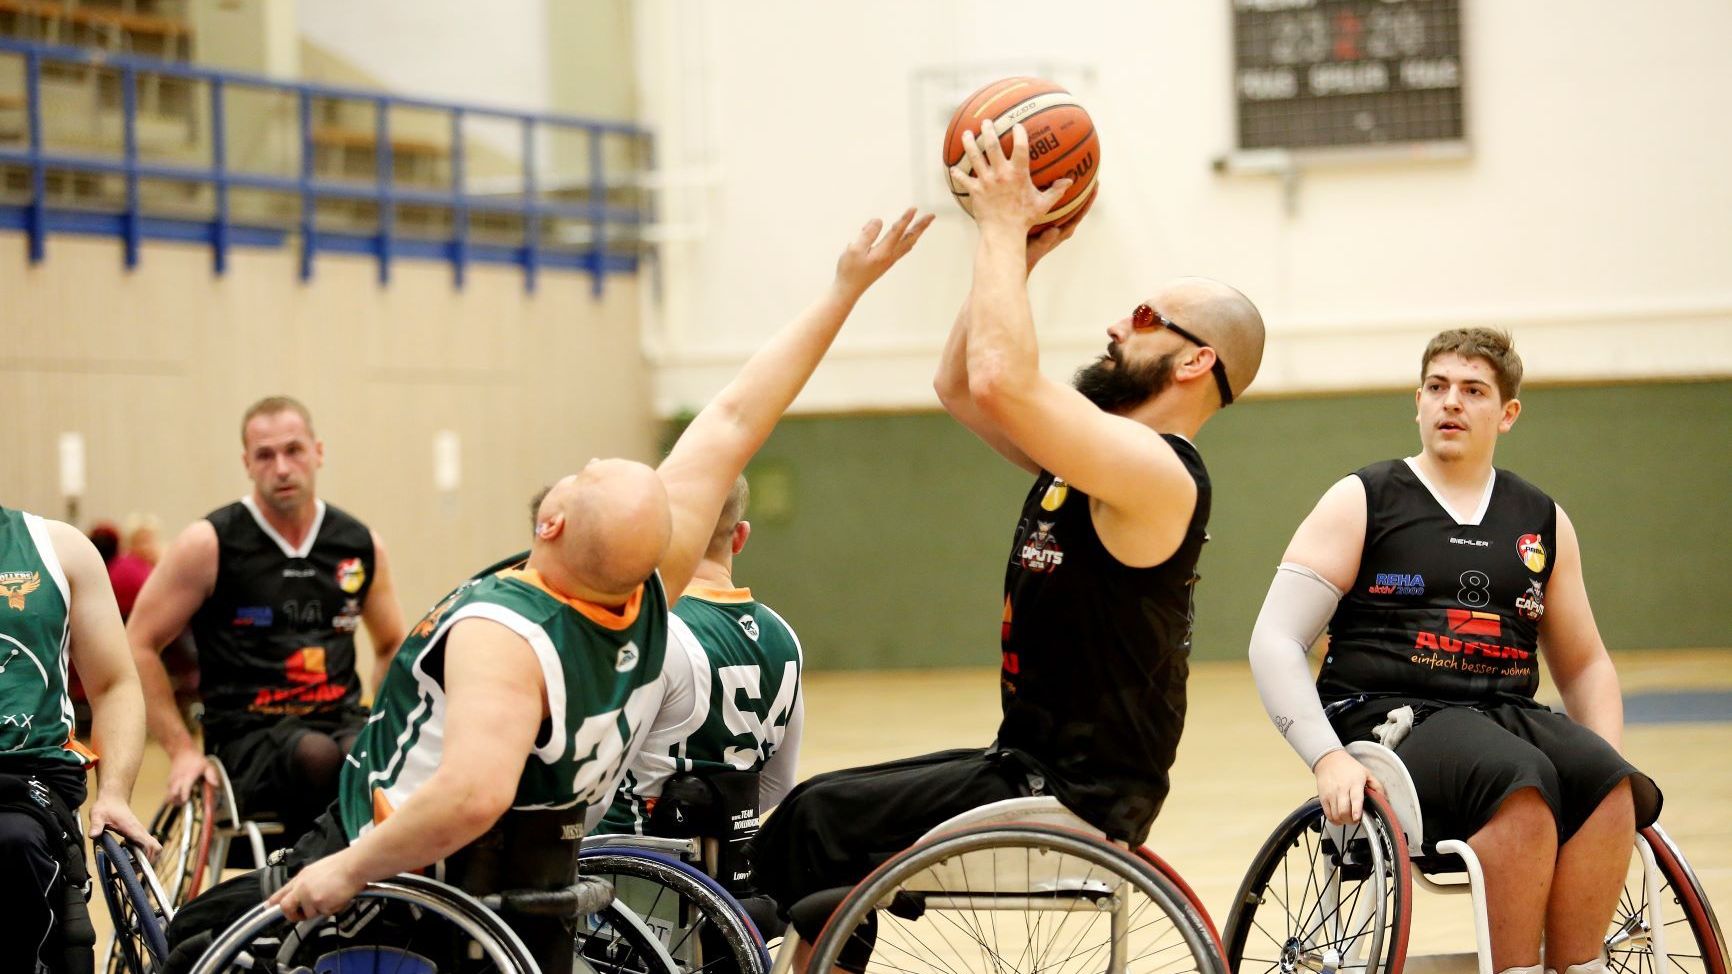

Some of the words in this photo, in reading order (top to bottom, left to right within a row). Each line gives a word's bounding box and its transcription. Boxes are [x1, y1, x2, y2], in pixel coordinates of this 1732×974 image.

[1450, 538, 1489, 547] BIEHLER
[0, 572, 33, 582] OLLERS
[1375, 573, 1425, 586] REHA
[1457, 570, 1490, 608] 8
[1411, 654, 1459, 670] einfach
[1461, 658, 1499, 673] besser
[719, 661, 798, 772] 54
